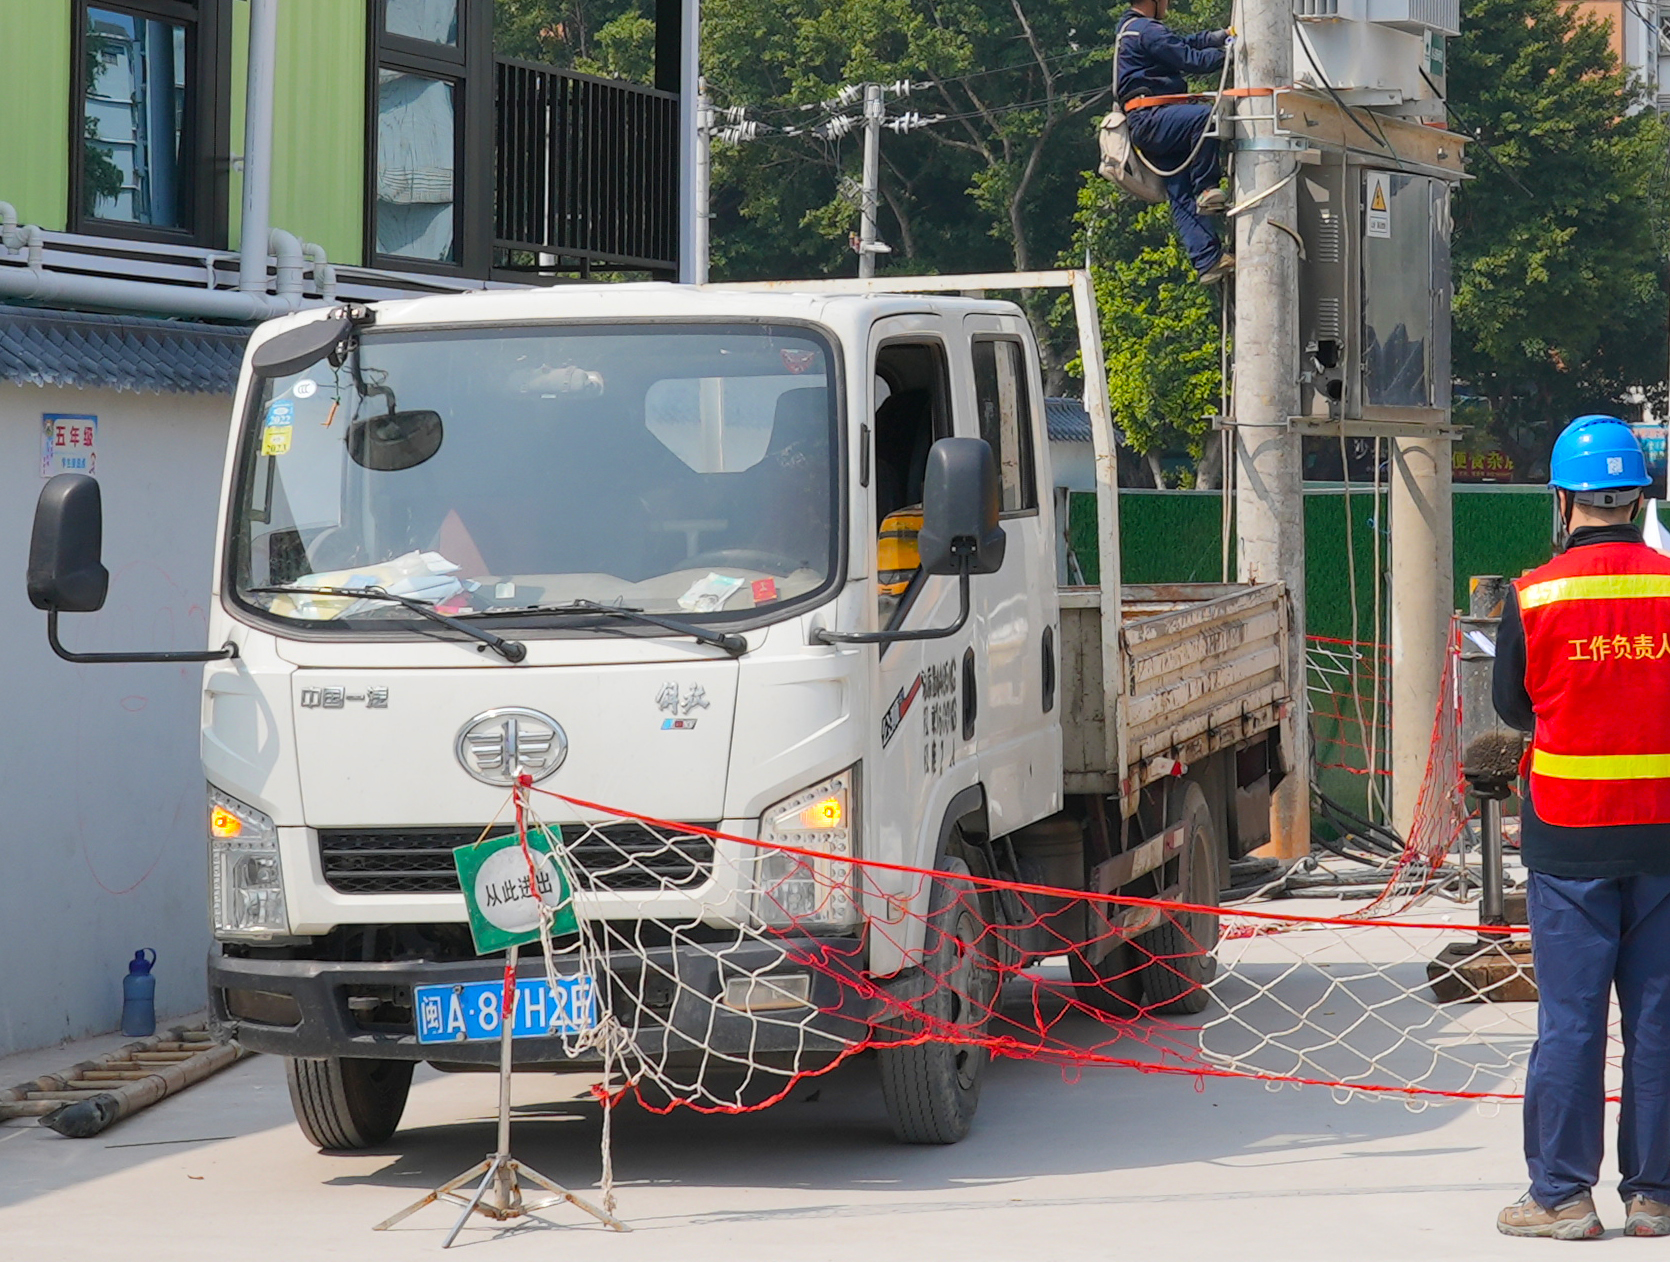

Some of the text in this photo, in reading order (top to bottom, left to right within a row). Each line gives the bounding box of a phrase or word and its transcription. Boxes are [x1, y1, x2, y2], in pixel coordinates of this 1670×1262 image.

[55, 425, 94, 447] 五年级
[301, 685, 389, 709] 中国一汽
[655, 681, 710, 716] 解放
[485, 871, 554, 908] 从此进出
